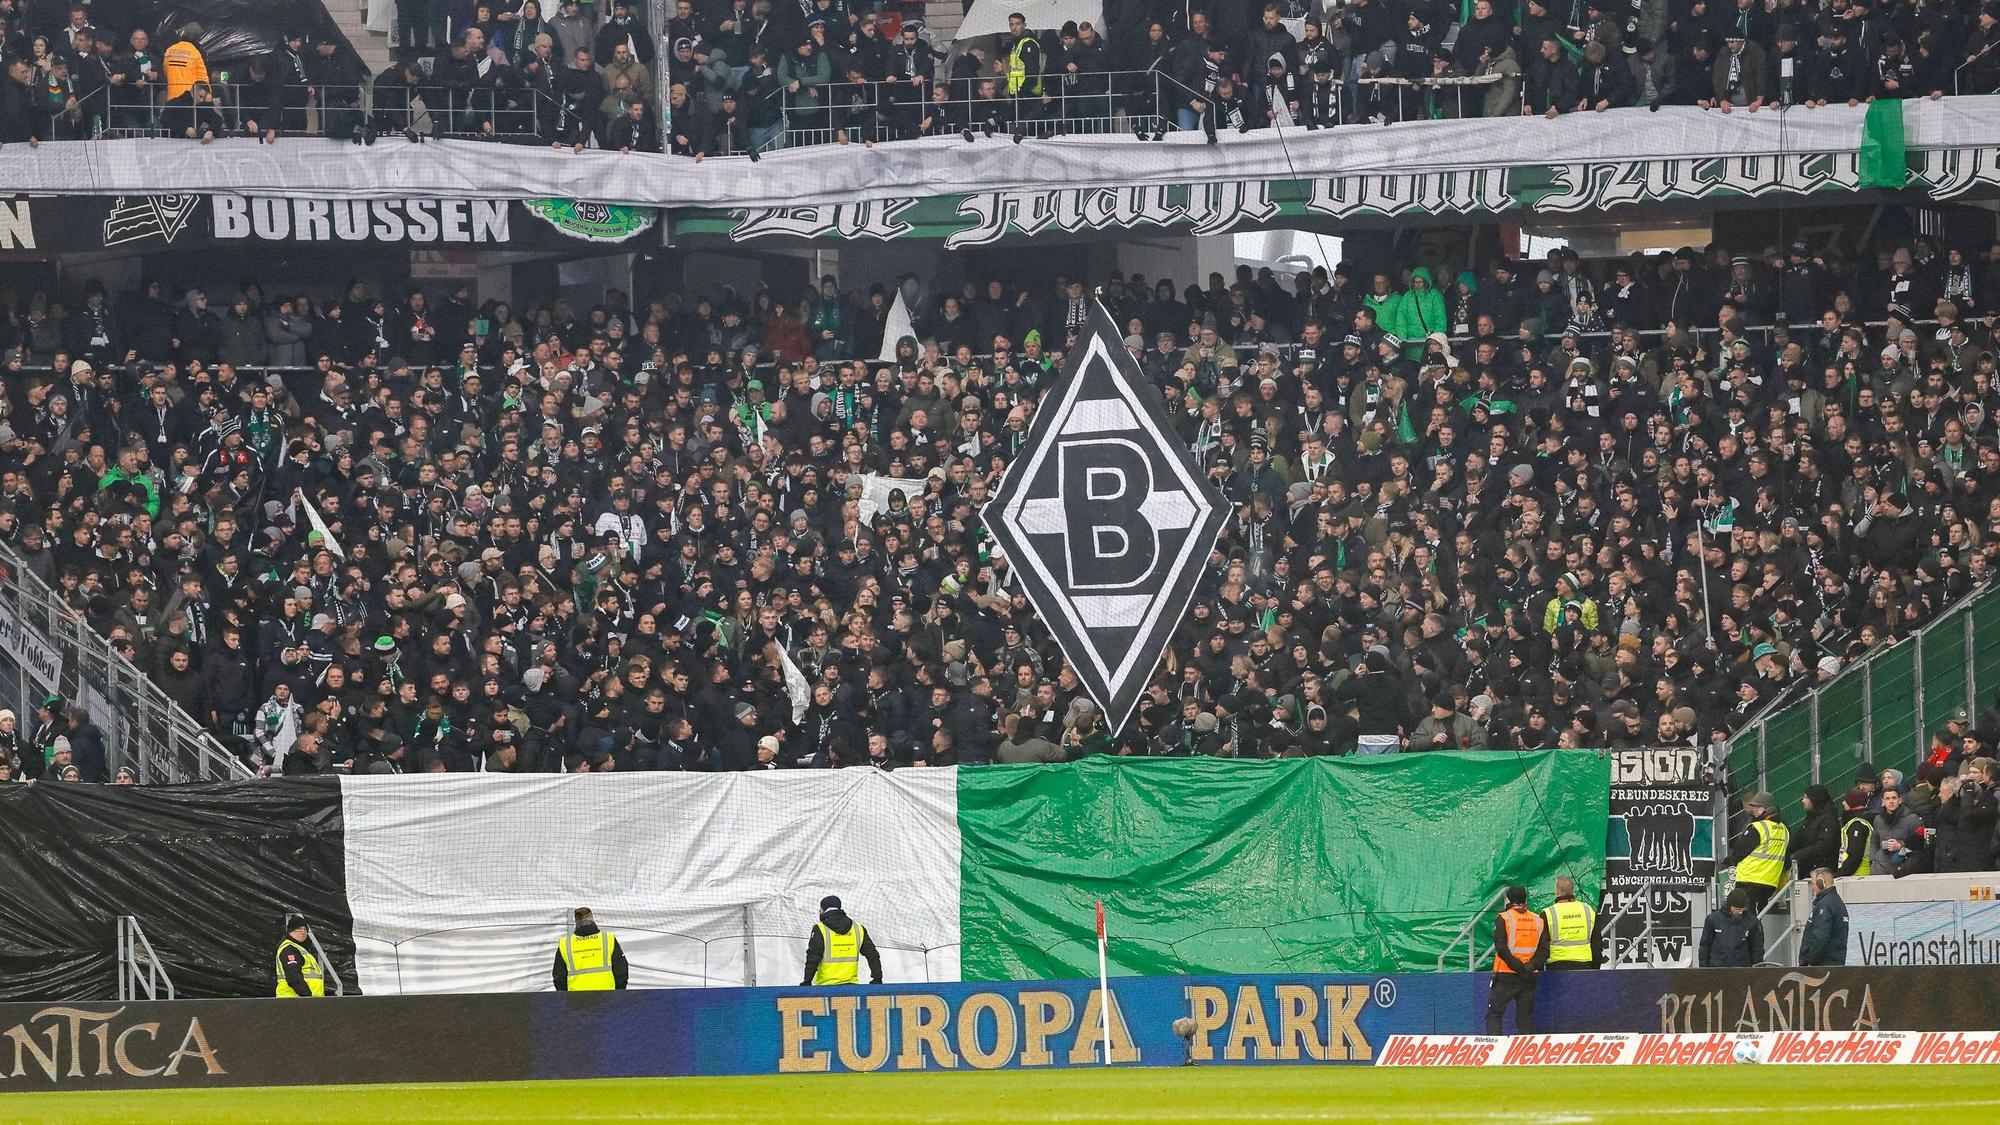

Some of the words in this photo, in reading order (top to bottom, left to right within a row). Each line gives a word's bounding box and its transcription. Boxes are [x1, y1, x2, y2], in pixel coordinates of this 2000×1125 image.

[212, 194, 510, 242] BORUSSEN
[1058, 438, 1160, 589] B
[1610, 788, 1710, 801] FREUNDESKREIS
[1611, 875, 1705, 886] MÖNCHENGLADBACH
[0, 1005, 229, 1083] NTICA
[776, 987, 1141, 1073] EUROPA
[1382, 1036, 1495, 1066] WeberHaus
[1502, 1035, 1625, 1065] WeberHaus
[1631, 1034, 1760, 1065] WeberHa
[1767, 1032, 1902, 1064] WeberHaus
